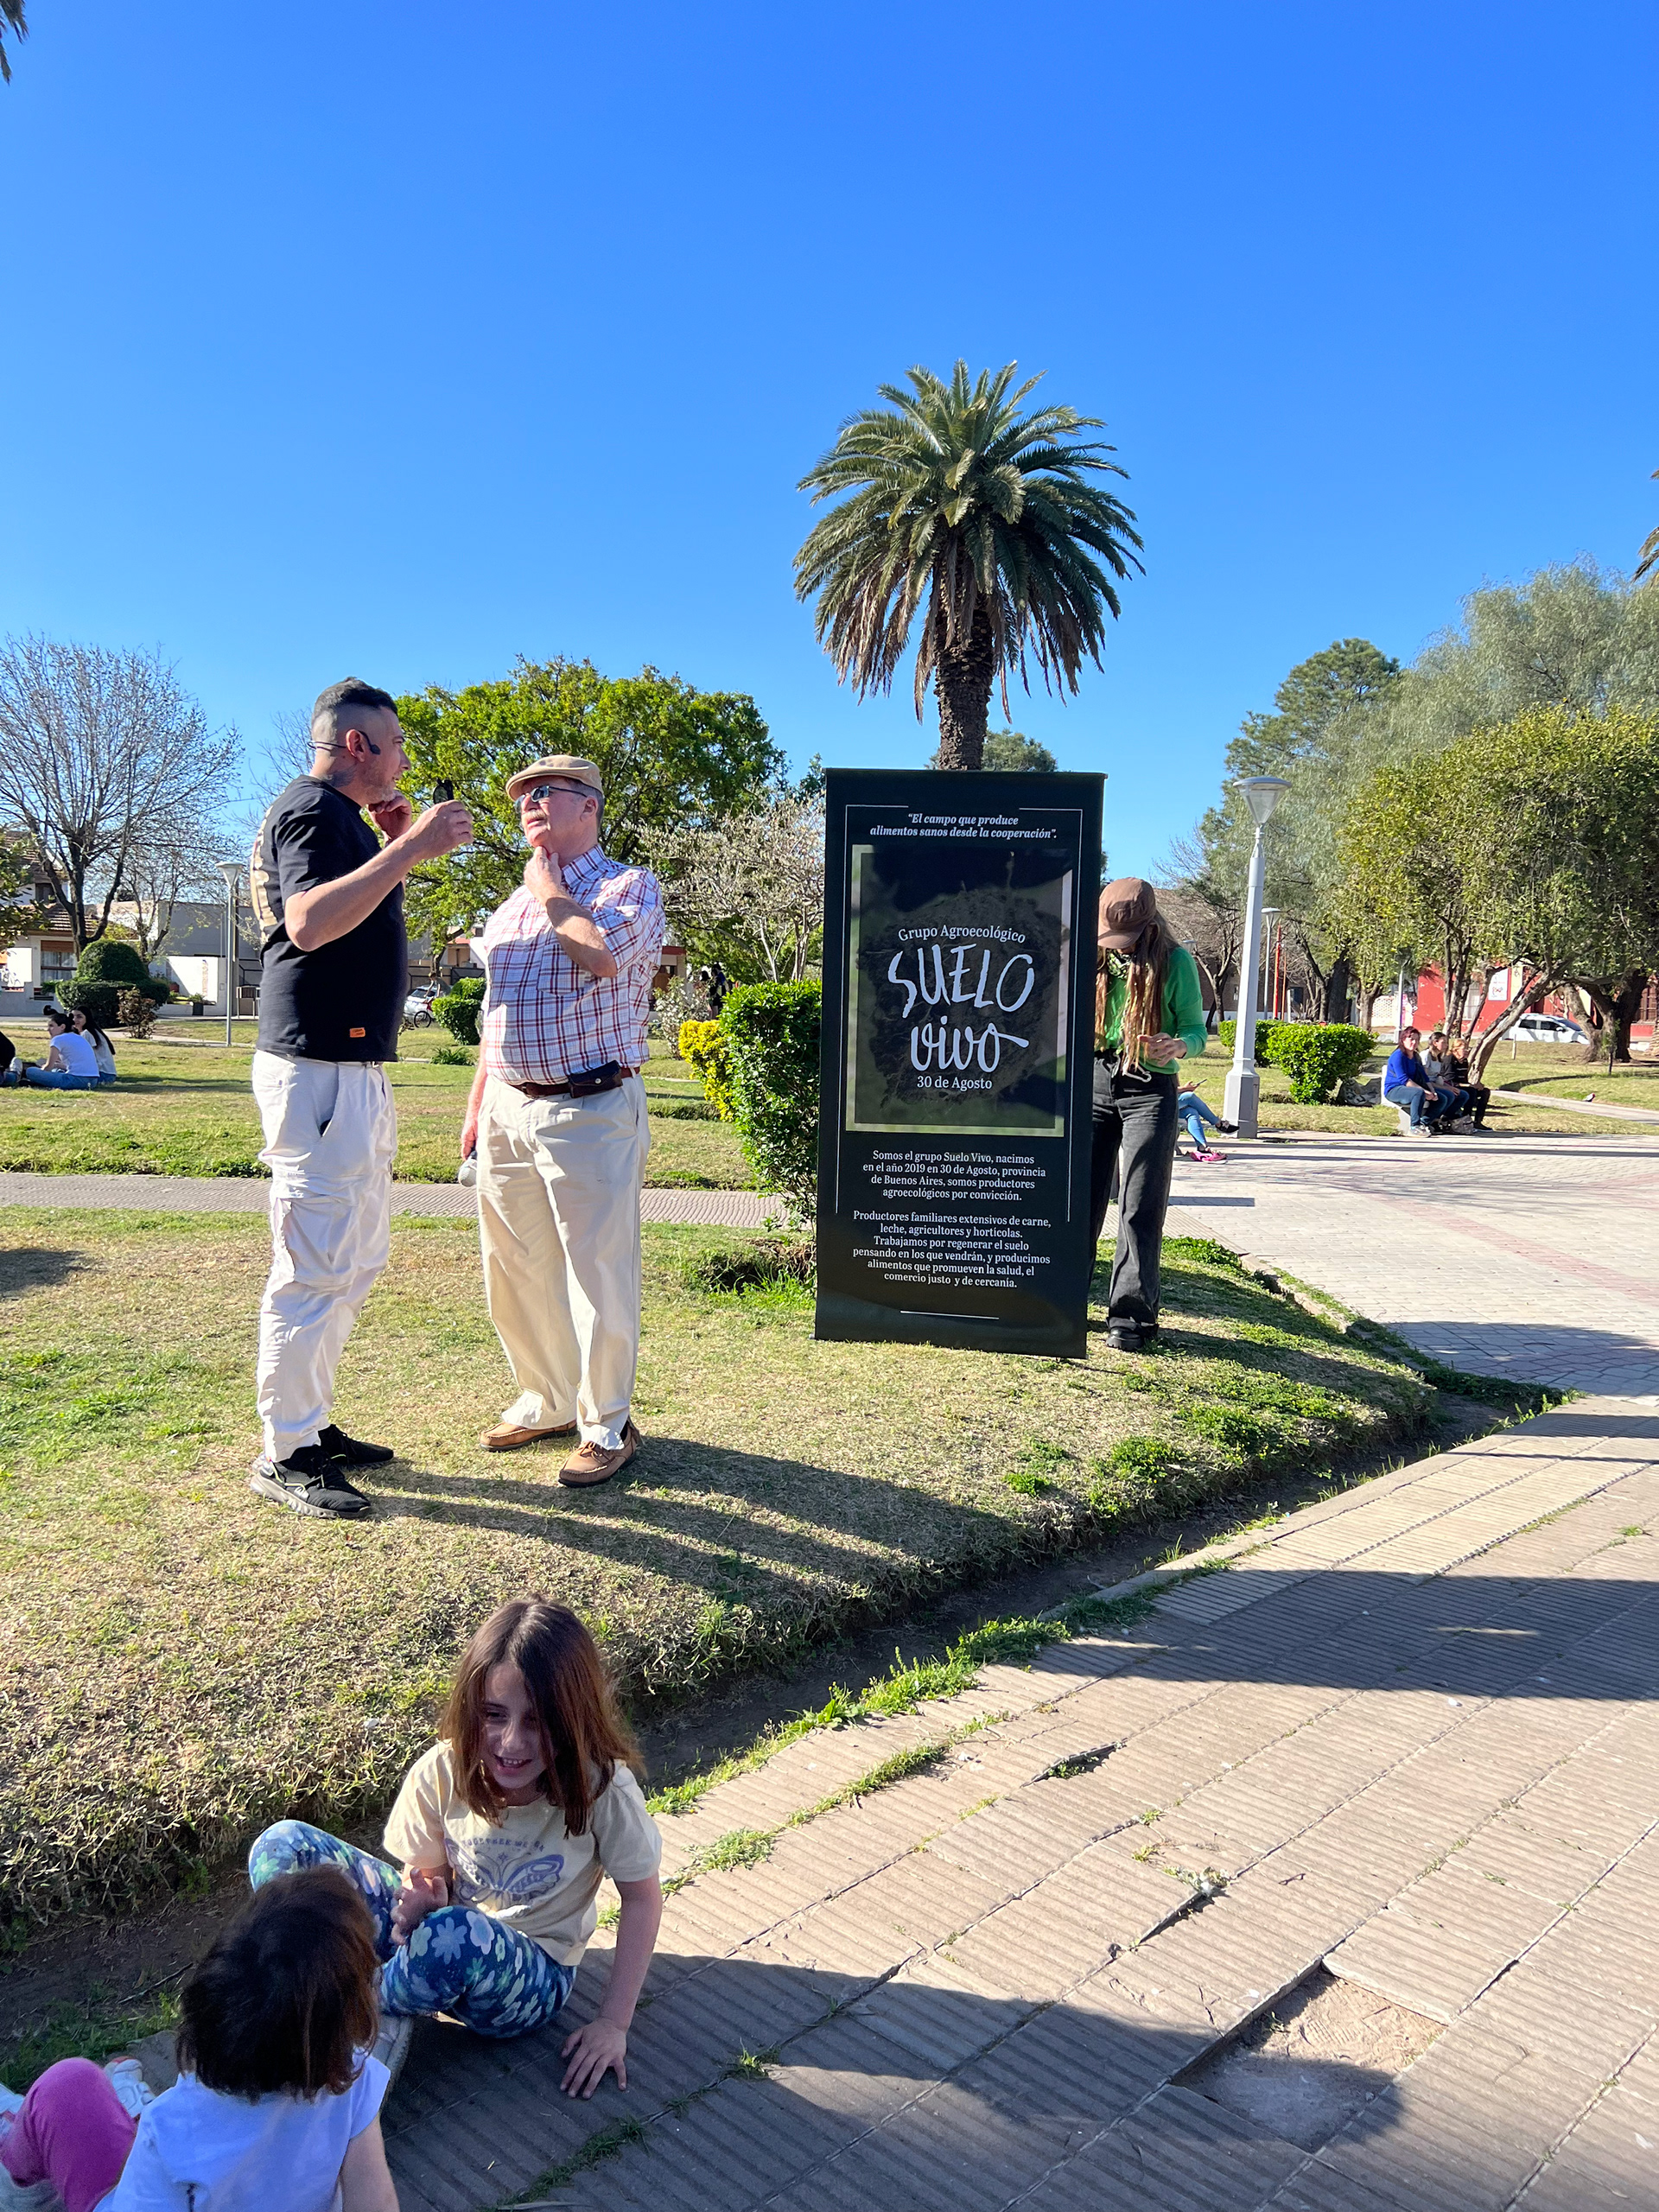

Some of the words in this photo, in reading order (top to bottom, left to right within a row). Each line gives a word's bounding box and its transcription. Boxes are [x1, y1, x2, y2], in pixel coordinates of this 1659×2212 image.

[924, 816, 957, 826] campo
[957, 817, 976, 827] que
[976, 814, 1019, 827] produce
[869, 824, 918, 836] alimentos
[949, 826, 978, 837] desde
[979, 827, 989, 837] la
[898, 926, 938, 942] Grupo
[940, 925, 1026, 944] Agroecológico
[887, 944, 1035, 1019] SUELO
[917, 1075, 932, 1088] 30
[934, 1075, 950, 1089] de
[951, 1077, 993, 1092] Agosto
[873, 1149, 904, 1160] Somos
[905, 1150, 913, 1160] el
[914, 1153, 943, 1164] grupo
[943, 1151, 969, 1162] Suelo
[970, 1152, 994, 1164] Vivo,
[995, 1154, 1035, 1165] nacimos
[875, 1161, 885, 1173] el
[886, 1163, 903, 1173] año
[904, 1163, 925, 1173] 2019
[939, 1164, 952, 1174] 30
[953, 1164, 965, 1174] de
[965, 1165, 1001, 1177] Agosto,
[1001, 1166, 1046, 1178] provincia
[870, 1173, 882, 1185] de
[884, 1174, 918, 1185] Buenos
[918, 1175, 946, 1187] Aires,
[947, 1179, 977, 1187] somos
[978, 1177, 1035, 1190] productores
[882, 1187, 950, 1200] agroecológicos
[951, 1191, 969, 1201] por
[969, 1190, 1022, 1201] convicción.
[853, 1210, 910, 1222] Productores
[911, 1211, 957, 1224] familiares
[958, 1215, 1007, 1225] extensivos
[1008, 1215, 1020, 1226] de
[1021, 1217, 1052, 1229] carne,
[880, 1223, 907, 1236] leche,
[908, 1224, 965, 1236] agricultores
[965, 1228, 972, 1238] y
[973, 1226, 1023, 1238] hortícolas.
[873, 1235, 928, 1249] Trabajamos
[929, 1239, 946, 1249] por
[947, 1240, 993, 1250] regenerar
[994, 1239, 1003, 1250] el
[1004, 1240, 1029, 1251] suelo
[853, 1247, 897, 1258] pensando
[898, 1250, 910, 1259] en
[911, 1249, 925, 1259] los
[925, 1251, 944, 1262] que
[944, 1250, 986, 1263] vendrán,
[987, 1254, 994, 1264] y
[995, 1252, 1051, 1264] producimos
[867, 1258, 912, 1271] alimentos
[913, 1263, 931, 1273] que
[932, 1264, 985, 1274] promueven
[986, 1263, 995, 1274] la
[996, 1264, 1025, 1277] salud,
[1026, 1265, 1034, 1276] el
[884, 1273, 926, 1283] comercio
[927, 1273, 951, 1285] justo
[954, 1277, 961, 1287] y
[961, 1275, 974, 1286] de
[975, 1277, 1018, 1288] cercanía.
